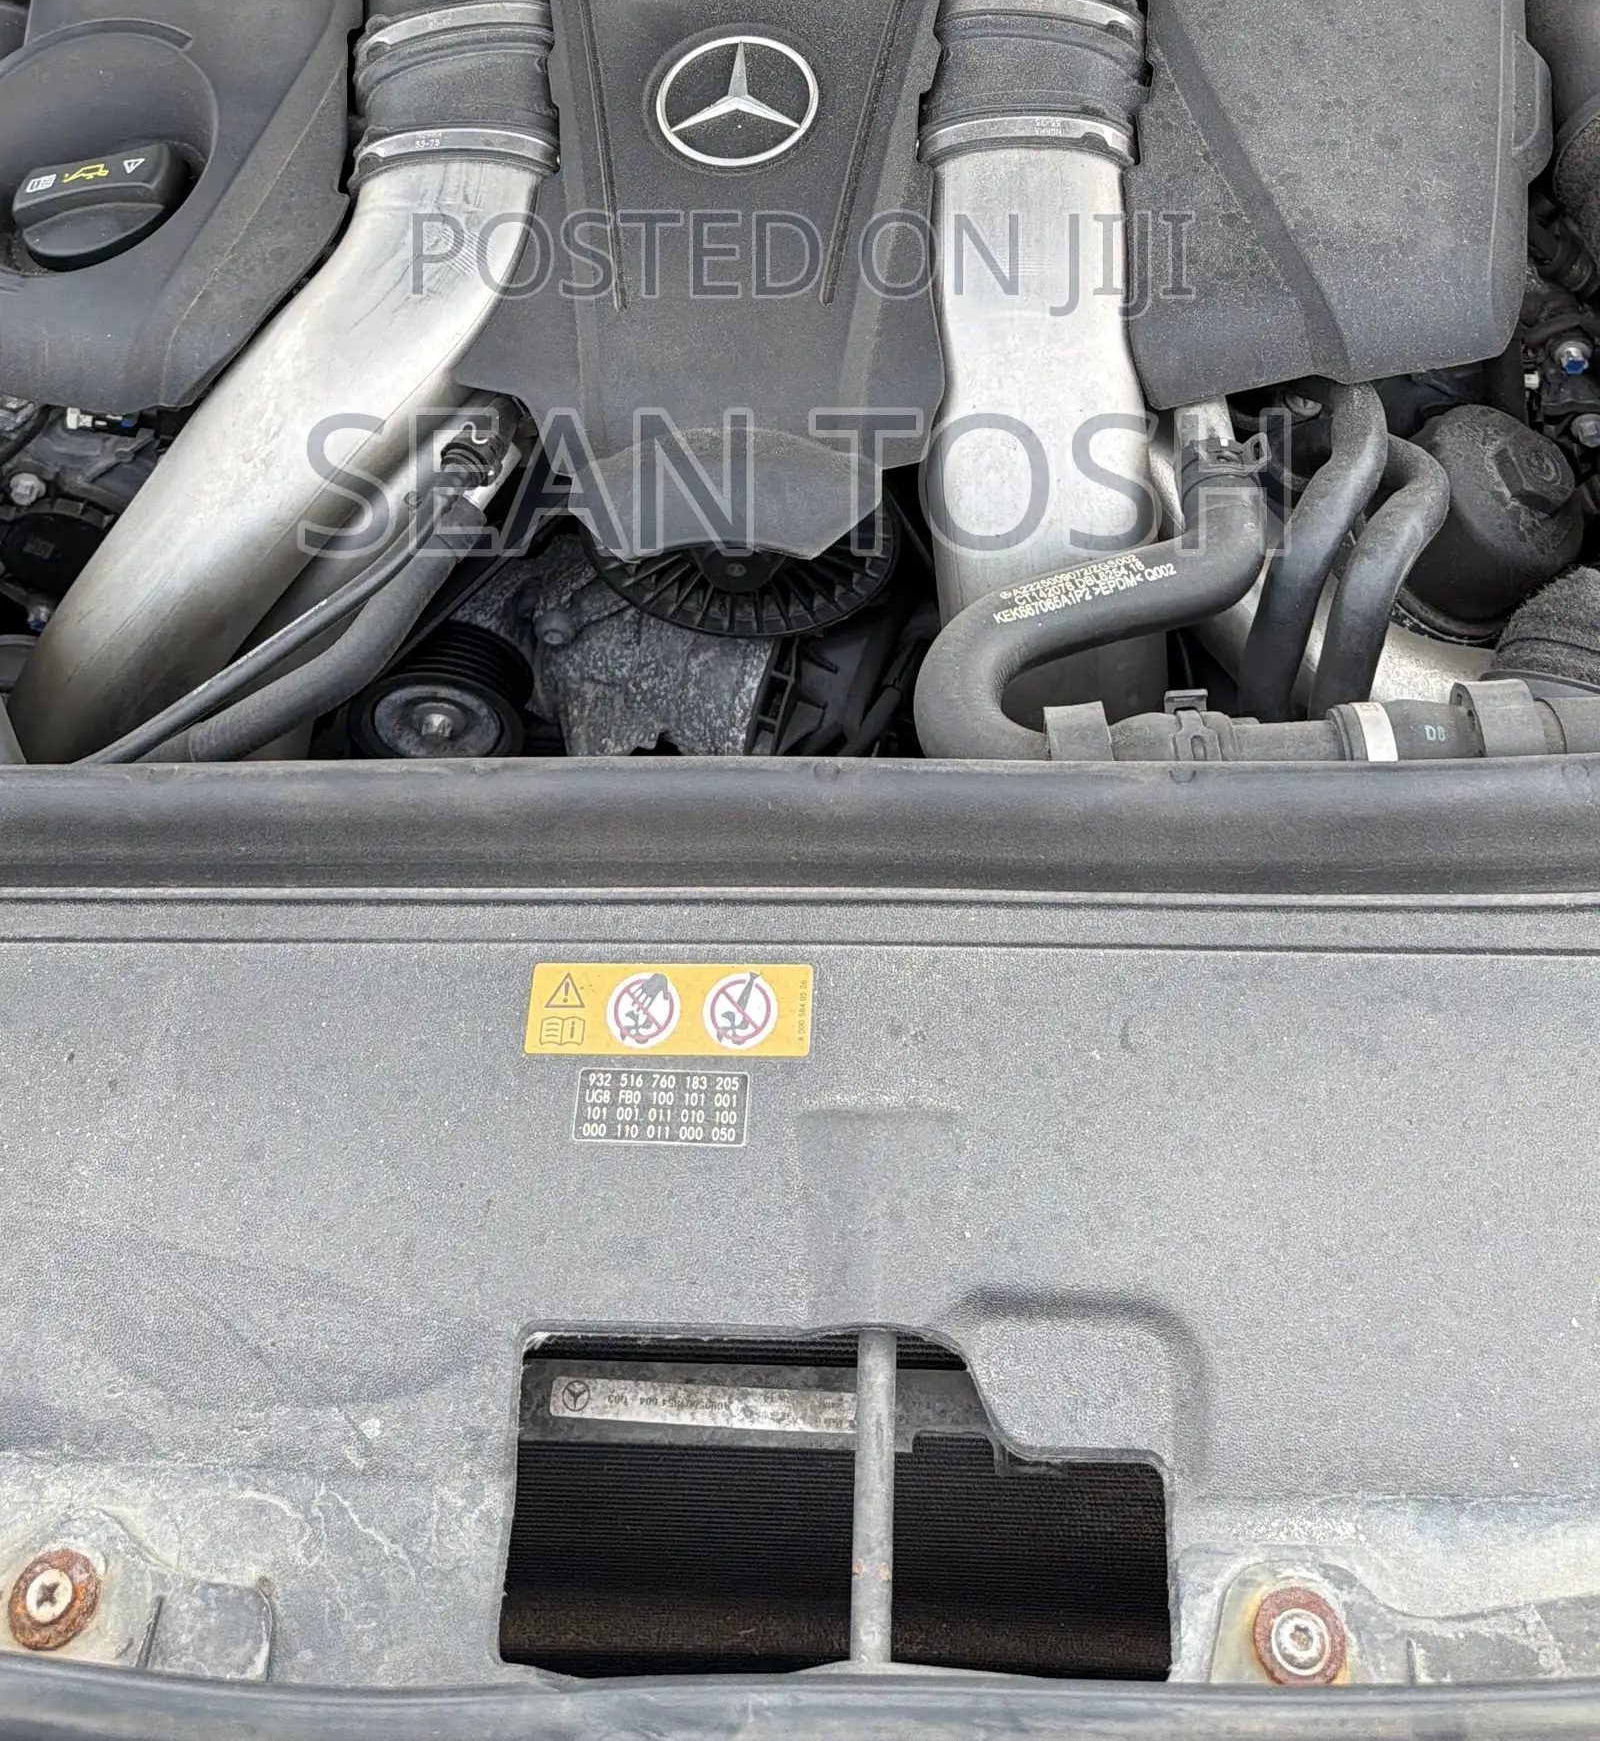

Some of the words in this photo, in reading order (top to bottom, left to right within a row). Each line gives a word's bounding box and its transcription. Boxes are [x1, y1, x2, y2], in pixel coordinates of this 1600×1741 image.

[1144, 563, 1177, 582] Q002
[589, 1073, 611, 1087] 932
[620, 1073, 643, 1087] 516
[652, 1074, 676, 1088] 760
[686, 1076, 707, 1090] 183
[716, 1077, 739, 1090] 205
[585, 1089, 610, 1103] UG8
[652, 1091, 674, 1105] 100
[685, 1092, 705, 1106] 101
[714, 1094, 737, 1107] 001
[587, 1106, 607, 1120] 101
[616, 1107, 639, 1121] 001
[648, 1108, 671, 1122] 011
[681, 1110, 704, 1123] 010
[715, 1111, 737, 1124] 100
[582, 1123, 606, 1136] 000
[617, 1124, 638, 1138] 110
[647, 1125, 669, 1139] 011
[679, 1127, 703, 1140] 000
[711, 1127, 735, 1141] 050
